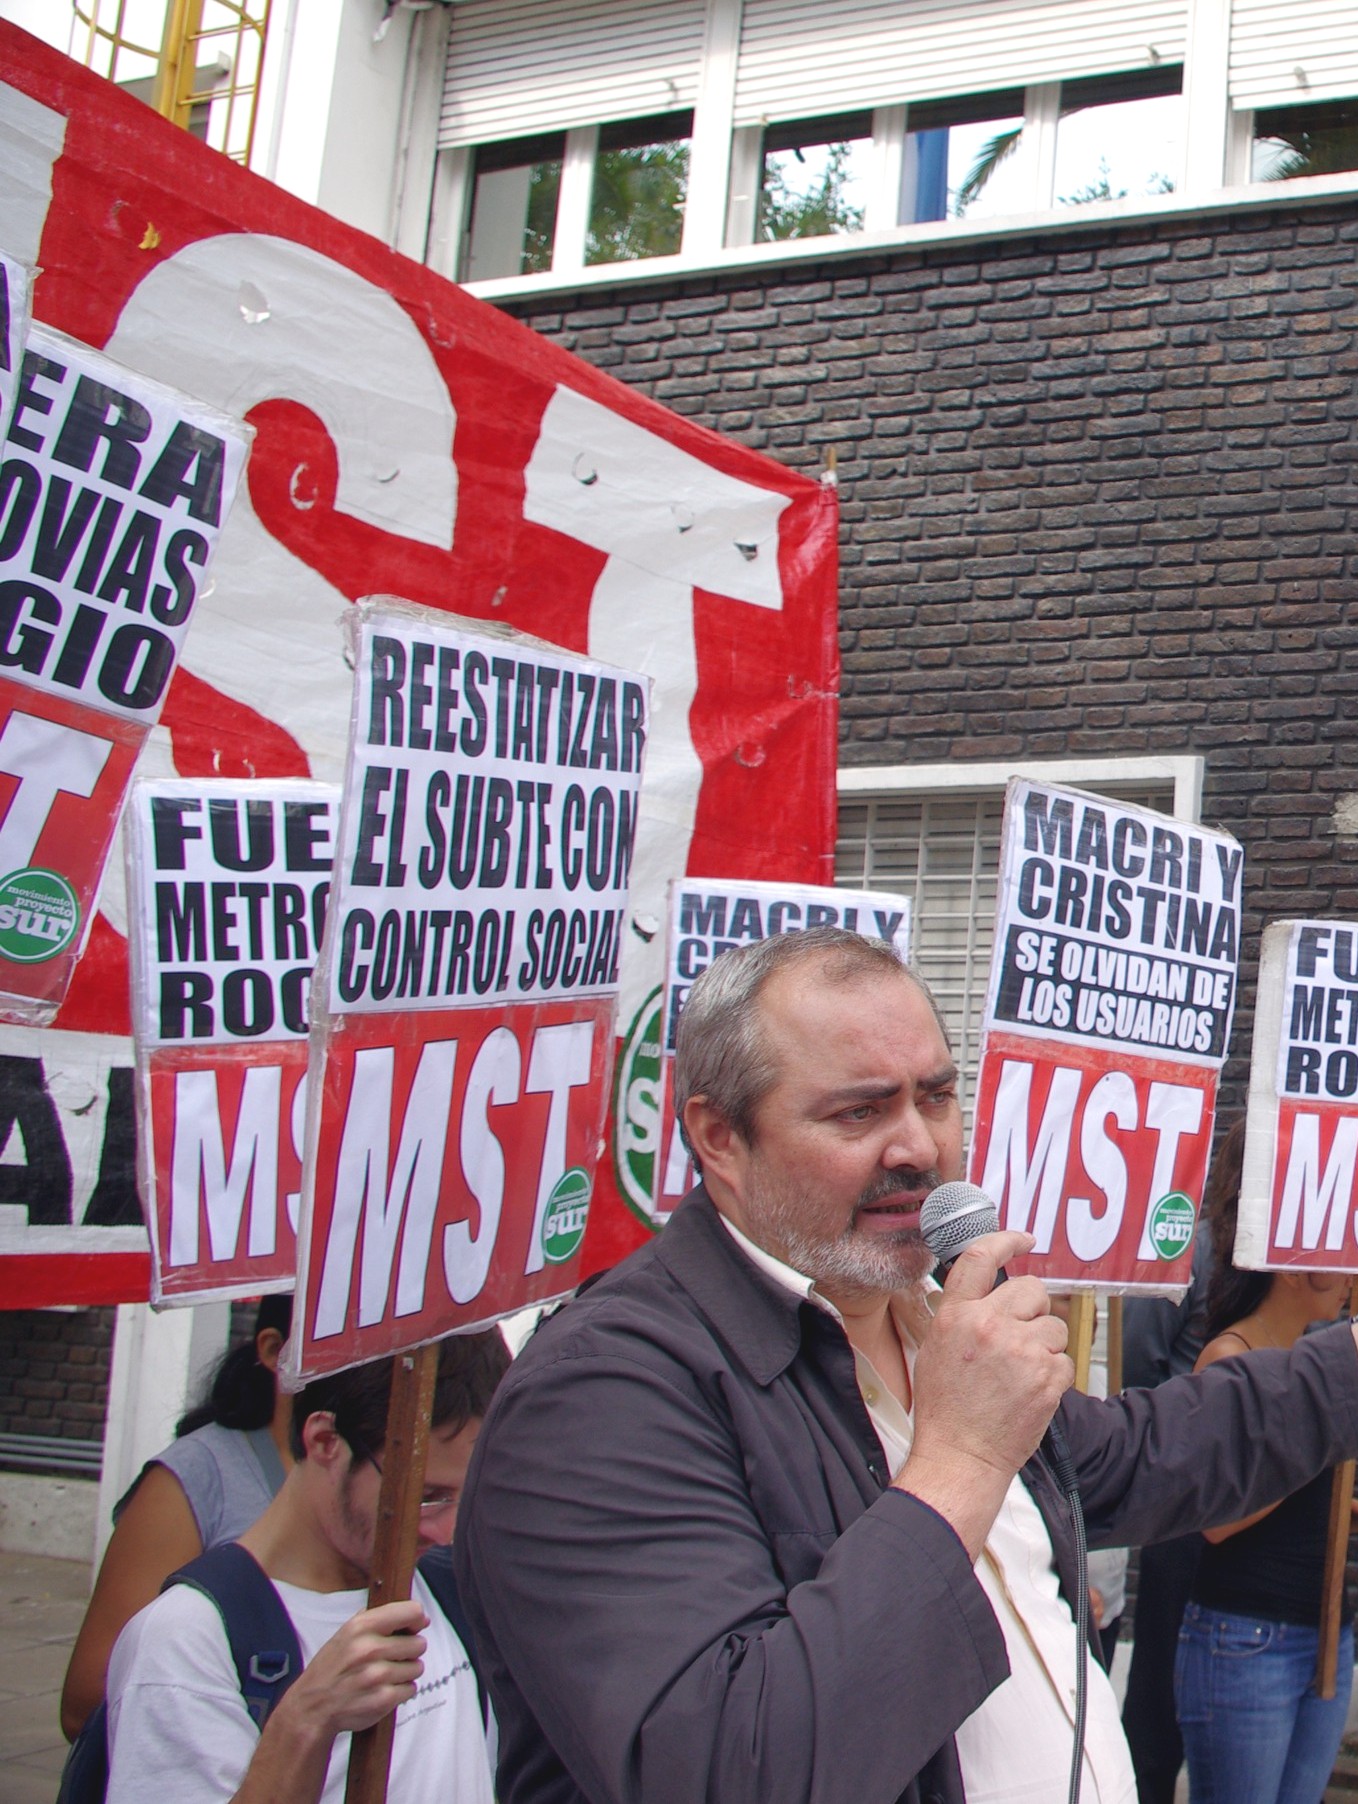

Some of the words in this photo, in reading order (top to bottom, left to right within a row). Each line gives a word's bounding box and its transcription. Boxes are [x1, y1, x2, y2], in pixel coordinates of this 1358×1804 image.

[7, 349, 227, 528] ERA
[0, 459, 209, 627] OVIAS
[0, 580, 175, 709] GIO
[367, 635, 647, 774] REESTATIZAR
[150, 796, 334, 873] FUE
[351, 766, 410, 888] EL
[418, 770, 553, 890] SUBTE
[561, 784, 640, 892] CON
[1023, 791, 1202, 893] MACRI
[1216, 844, 1242, 903] Y
[0, 904, 71, 942] sur
[14, 897, 73, 917] proyecto
[338, 908, 515, 1003] CONTROL
[518, 909, 625, 992] SOCIAL
[1018, 857, 1237, 964] CRISTINA
[1015, 931, 1057, 976] SE
[1060, 941, 1188, 1003] OLVIDAN
[1193, 969, 1230, 1010] DE
[1017, 977, 1073, 1029] LOS
[1076, 989, 1214, 1053] USUARIOS
[312, 1018, 595, 1341] MST
[981, 1058, 1205, 1263] MST
[544, 1205, 588, 1241] sur
[1154, 1221, 1192, 1242] sur
